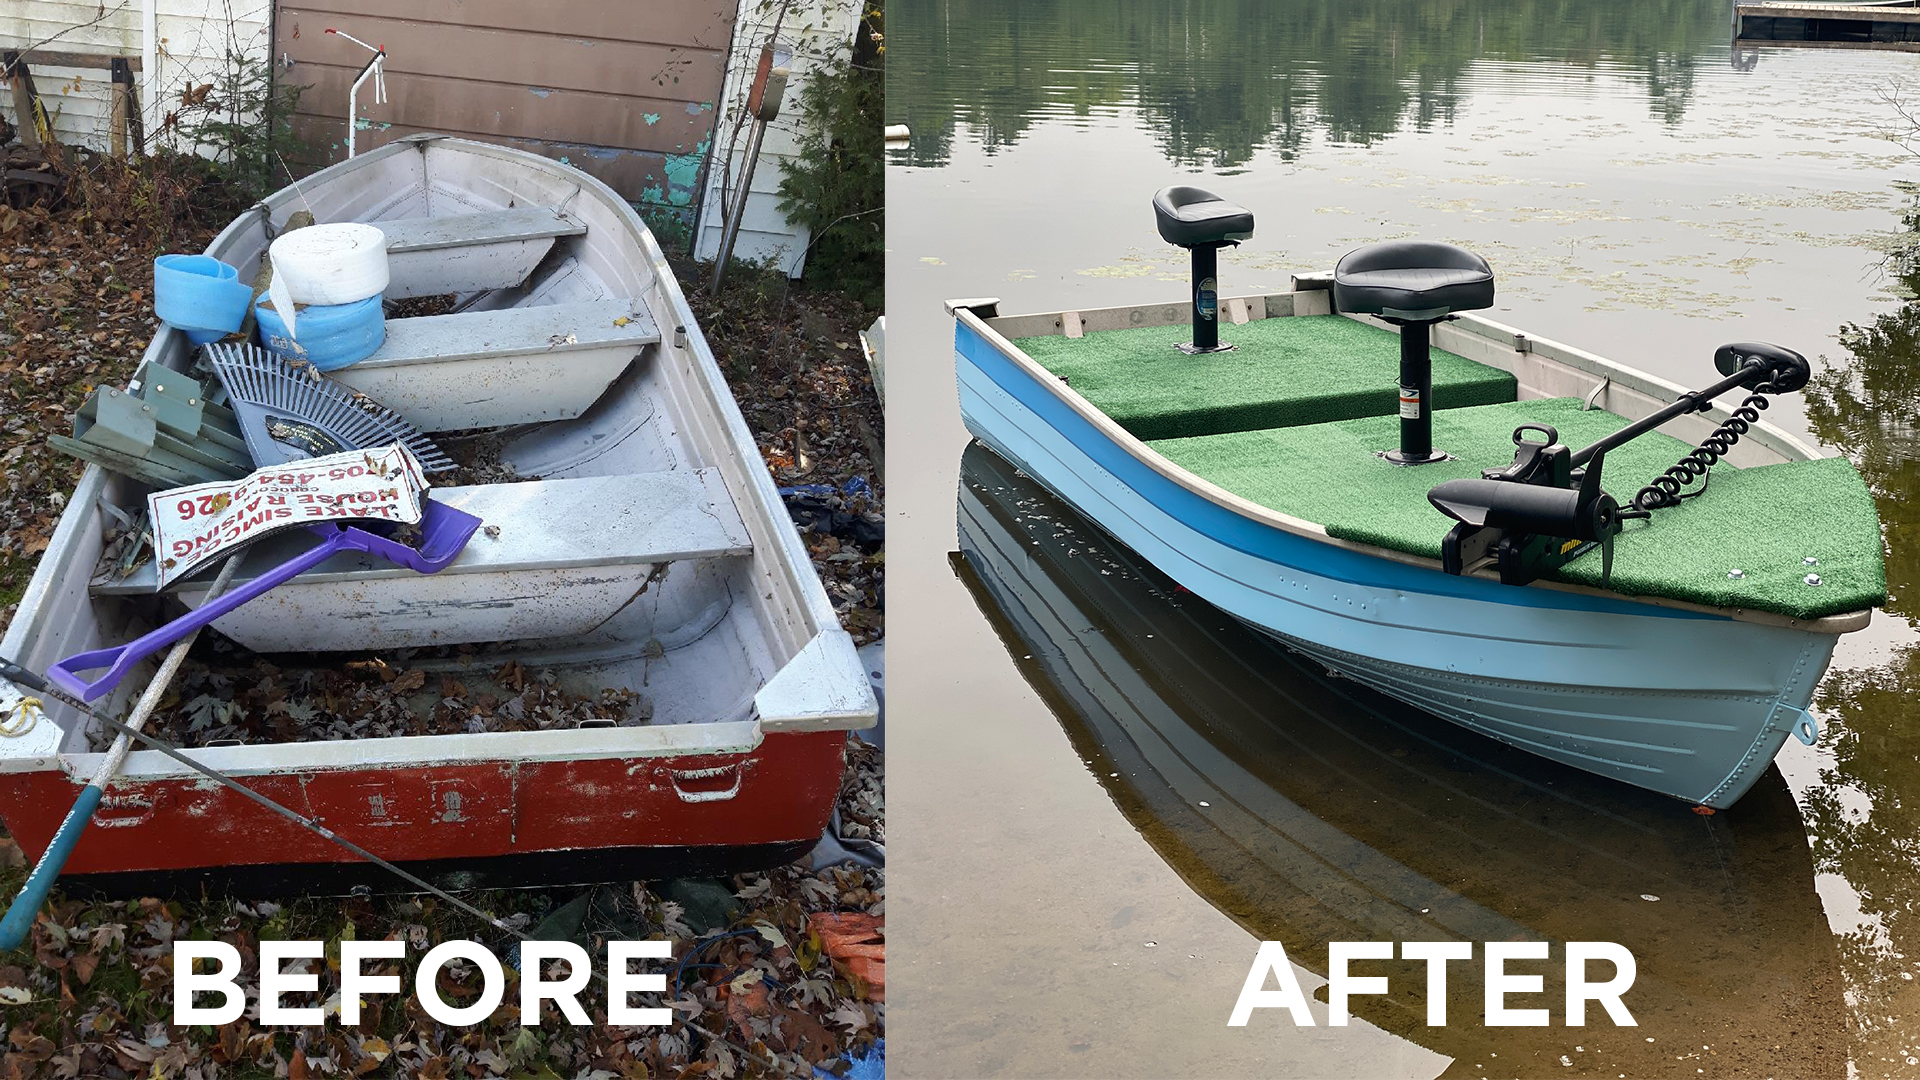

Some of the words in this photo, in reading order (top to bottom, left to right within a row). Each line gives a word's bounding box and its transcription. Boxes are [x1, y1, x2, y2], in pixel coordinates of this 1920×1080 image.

[177, 465, 380, 521] 05-454-926
[298, 487, 399, 503] HOUSE
[304, 505, 391, 517] LAKE
[172, 494, 286, 558] RAISING
[186, 507, 293, 567] SIMCOE
